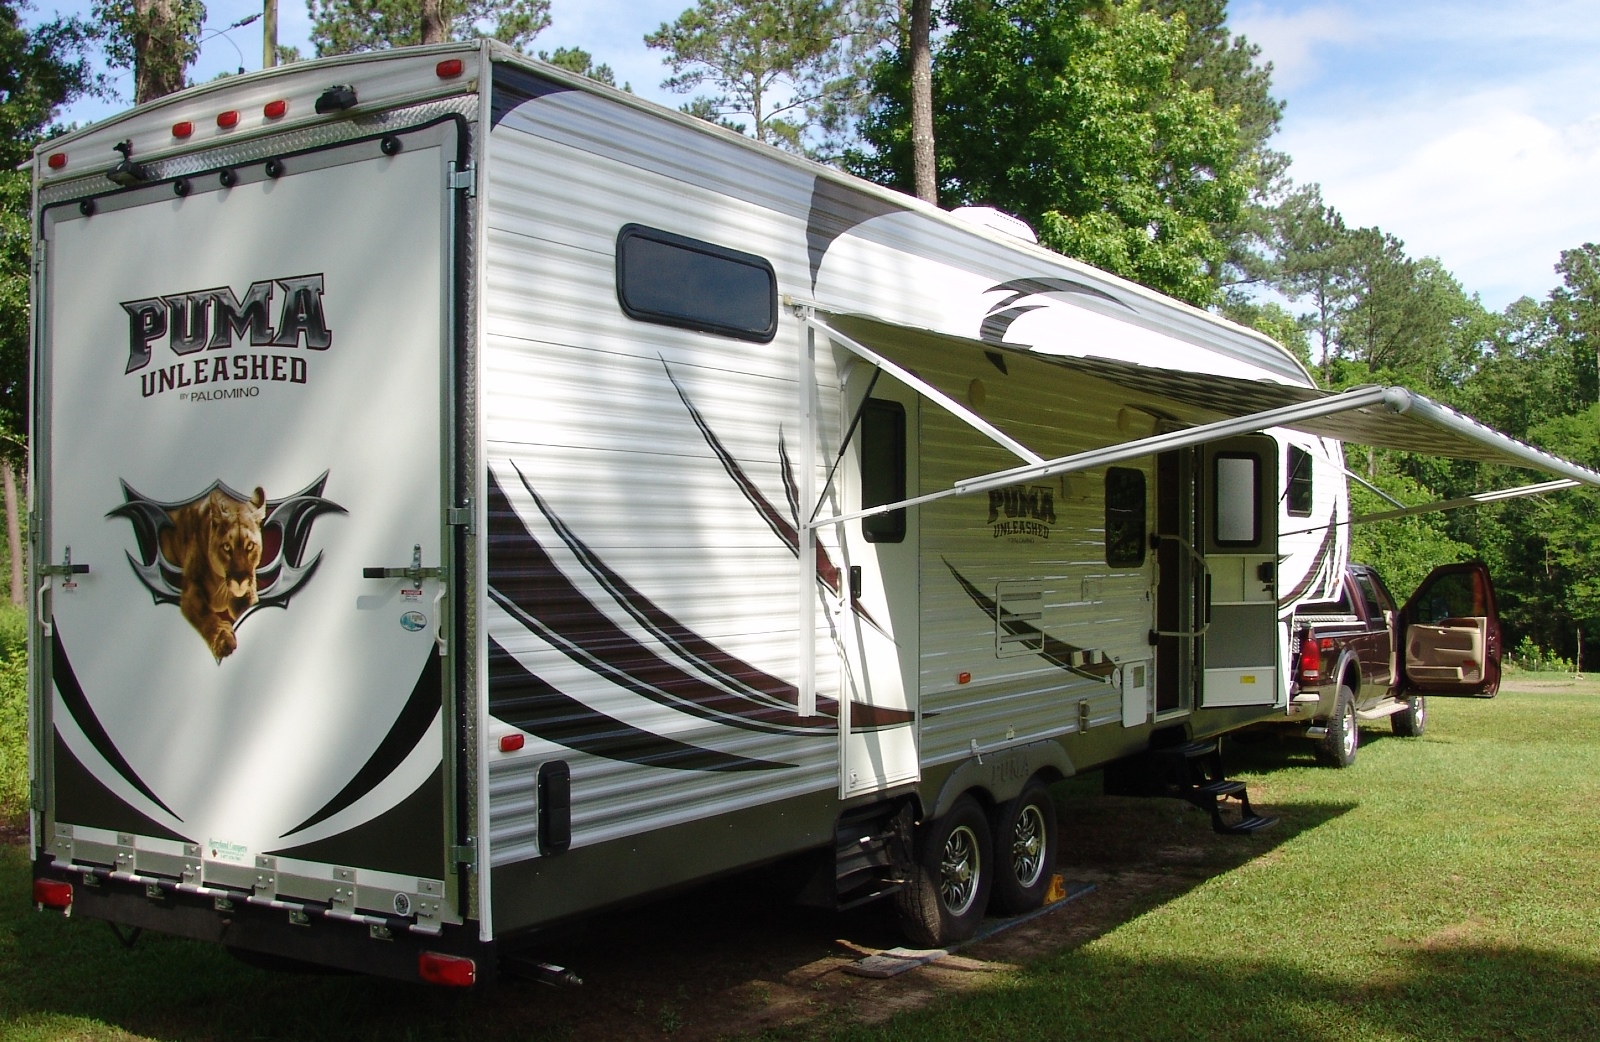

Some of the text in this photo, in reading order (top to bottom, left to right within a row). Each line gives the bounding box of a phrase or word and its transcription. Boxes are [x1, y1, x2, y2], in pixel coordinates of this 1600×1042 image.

[119, 272, 332, 376] PUMA
[141, 355, 307, 398] UNLEASHED
[179, 386, 260, 402] BY PALOMINO
[987, 484, 1057, 525] PUMA
[993, 520, 1050, 539] UNLEASHED
